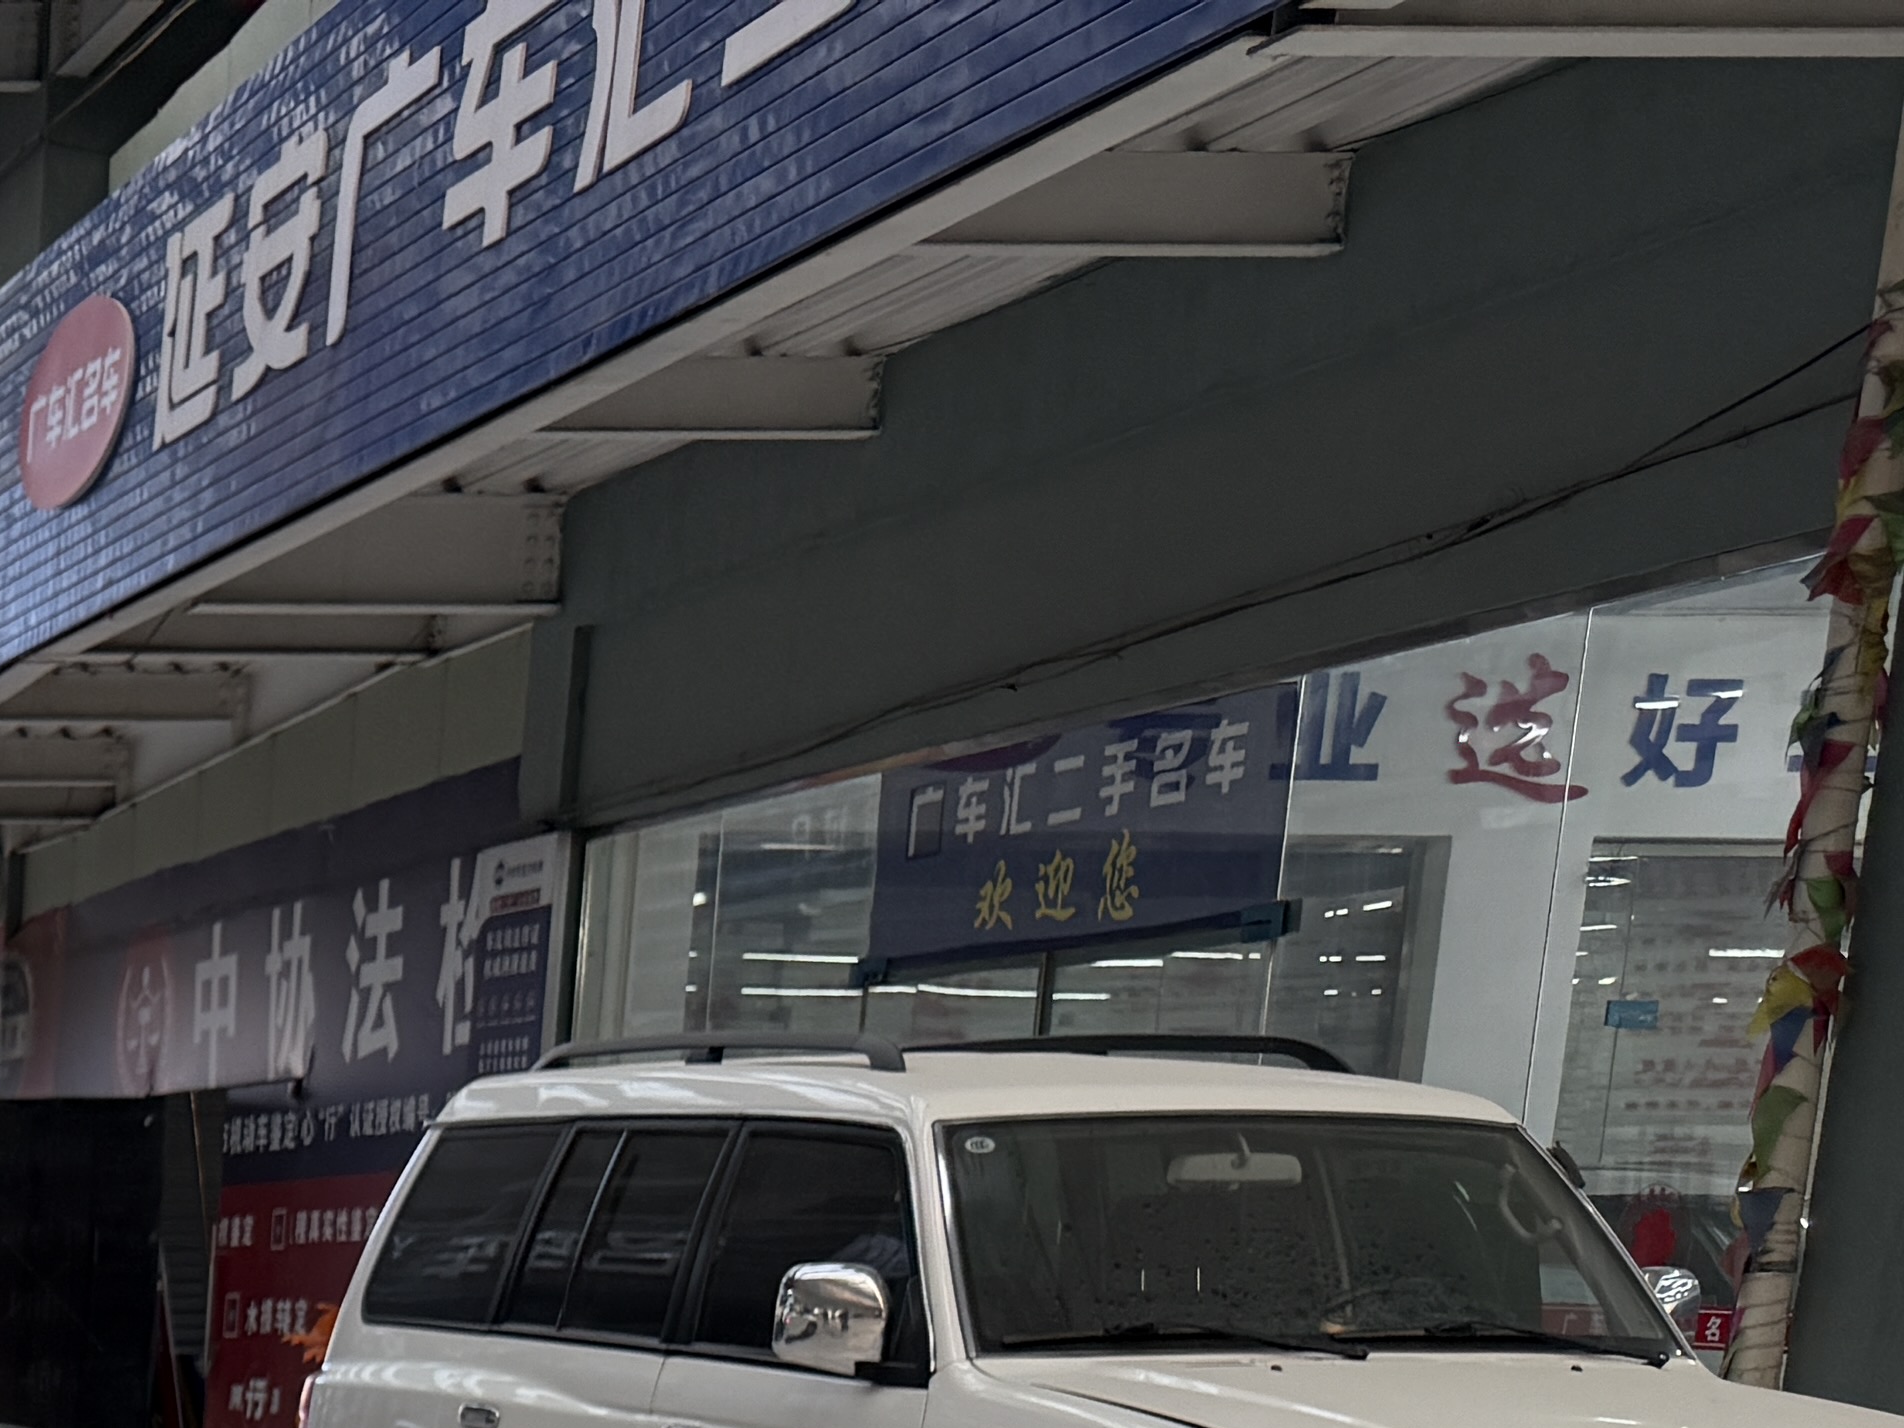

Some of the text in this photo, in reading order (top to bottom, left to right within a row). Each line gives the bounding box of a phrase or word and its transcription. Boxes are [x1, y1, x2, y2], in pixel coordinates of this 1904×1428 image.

[26, 346, 122, 464] 广车汇名车
[907, 719, 1250, 858] 广车汇二手名车
[973, 828, 1140, 931] 欢迎您
